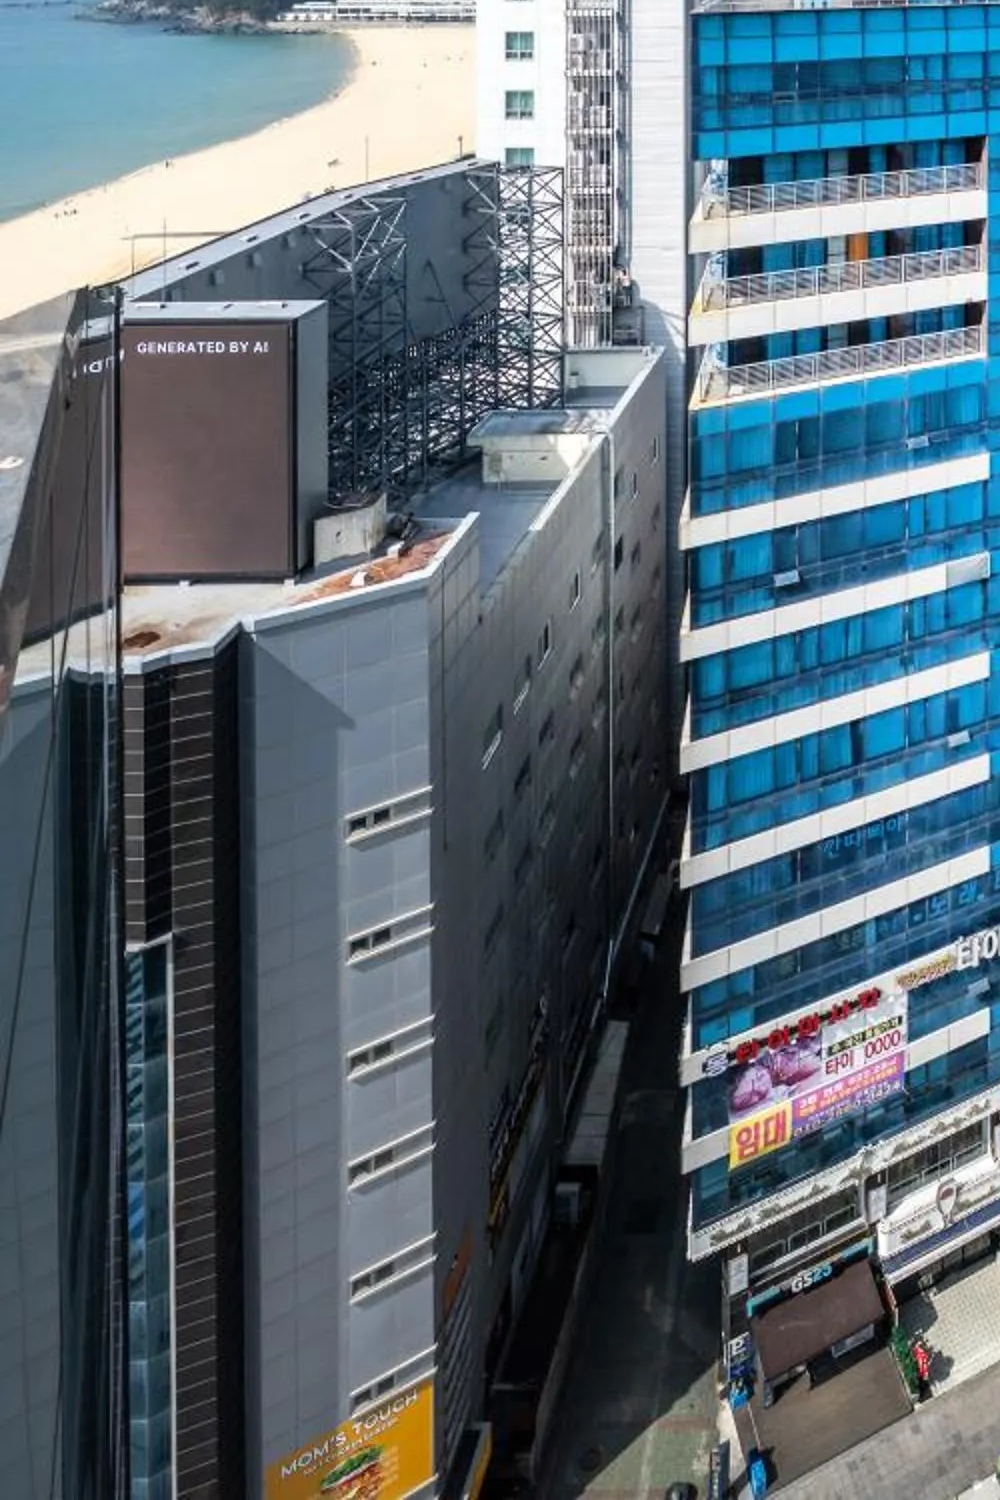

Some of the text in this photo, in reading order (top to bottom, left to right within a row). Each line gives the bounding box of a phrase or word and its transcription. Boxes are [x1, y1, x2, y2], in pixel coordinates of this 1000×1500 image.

[136, 340, 269, 354] GENERATED BY AI
[736, 1109, 787, 1161] 임대
[281, 1430, 347, 1478] MOM'S
[351, 1388, 418, 1436] TOUCH
